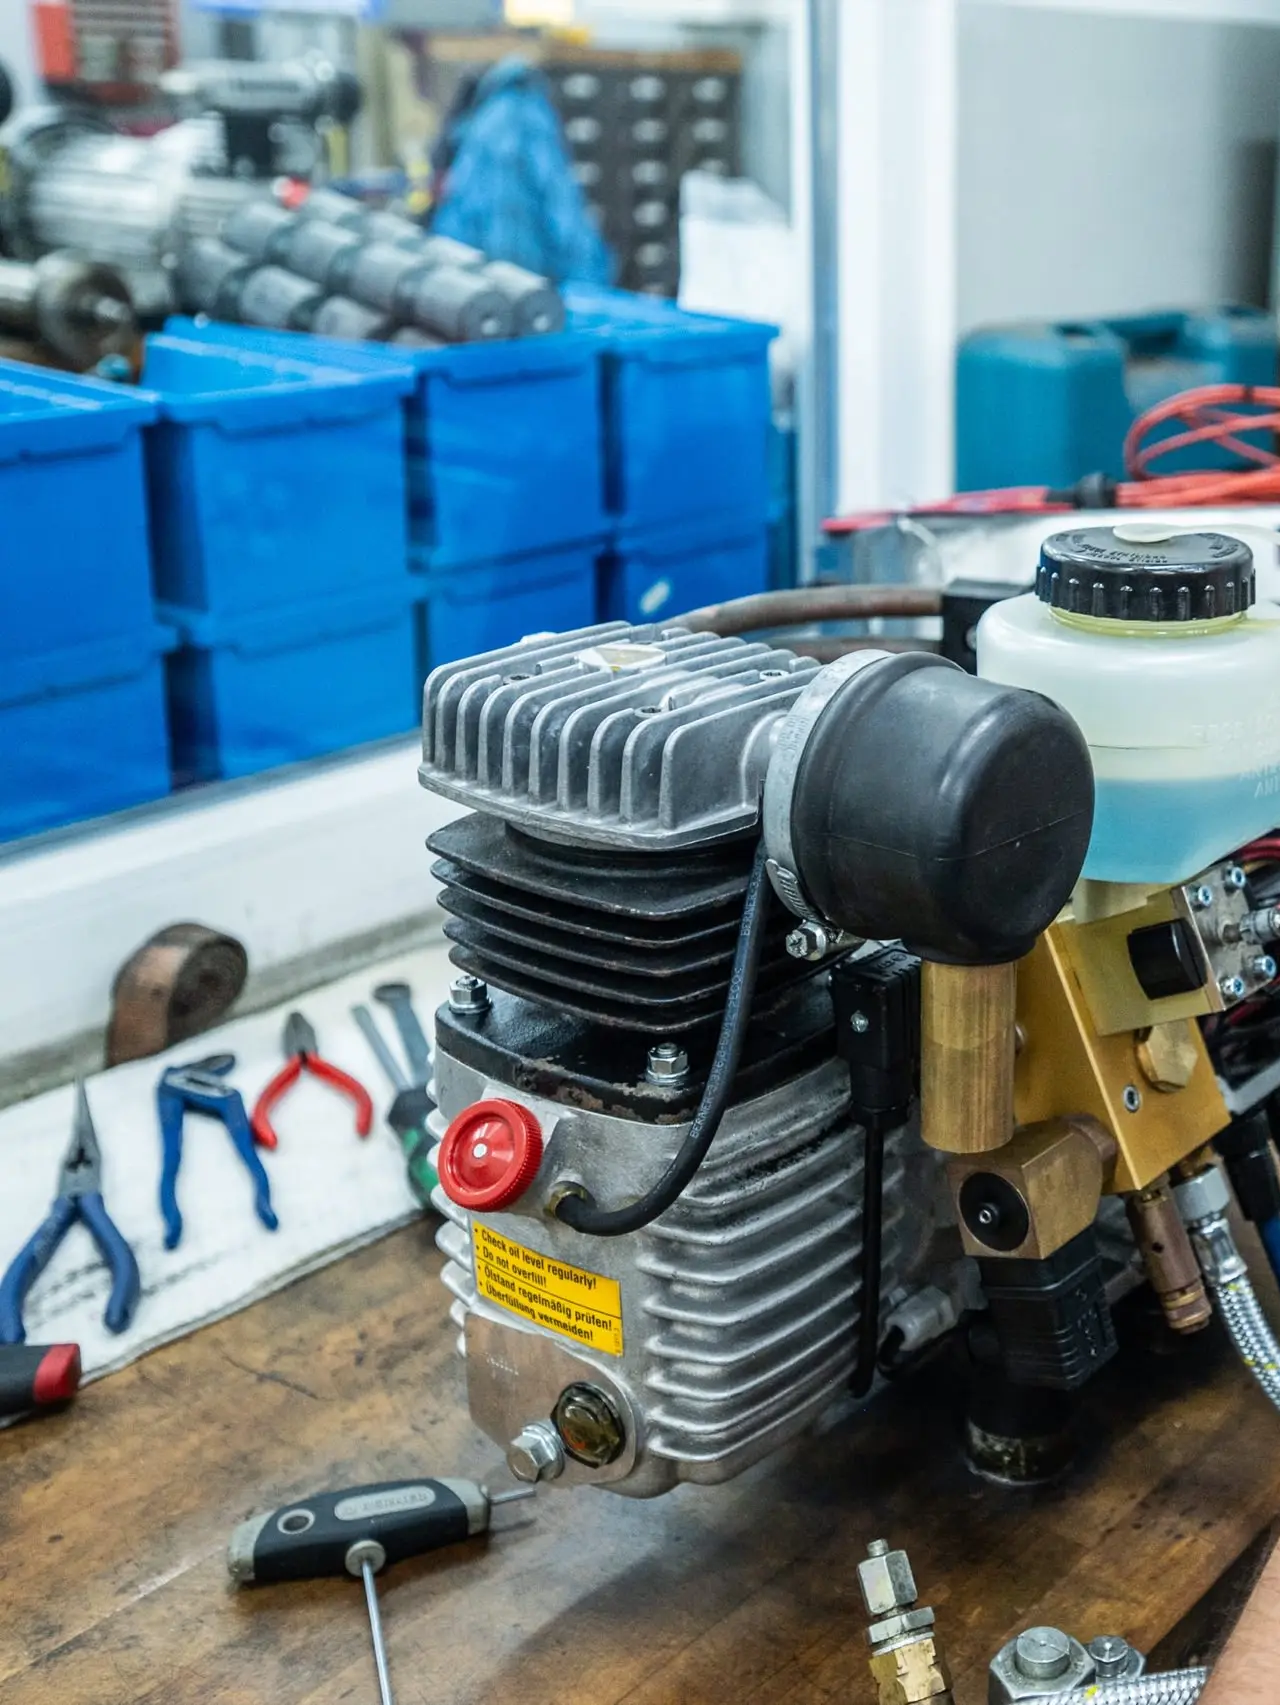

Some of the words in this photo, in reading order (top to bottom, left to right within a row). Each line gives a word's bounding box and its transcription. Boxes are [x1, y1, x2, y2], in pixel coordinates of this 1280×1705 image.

[481, 1229, 507, 1253] Check
[508, 1245, 520, 1259] oil
[522, 1250, 545, 1270] level
[547, 1263, 597, 1290] regularly!
[482, 1246, 494, 1261] Do
[495, 1255, 510, 1270] not
[511, 1264, 547, 1288] overfill!
[484, 1263, 516, 1292] Ölstand
[518, 1285, 572, 1320] regelmäßig
[574, 1309, 612, 1332] prüfen!
[486, 1280, 536, 1320] Überfüllung
[537, 1312, 594, 1341] vermeiden!
